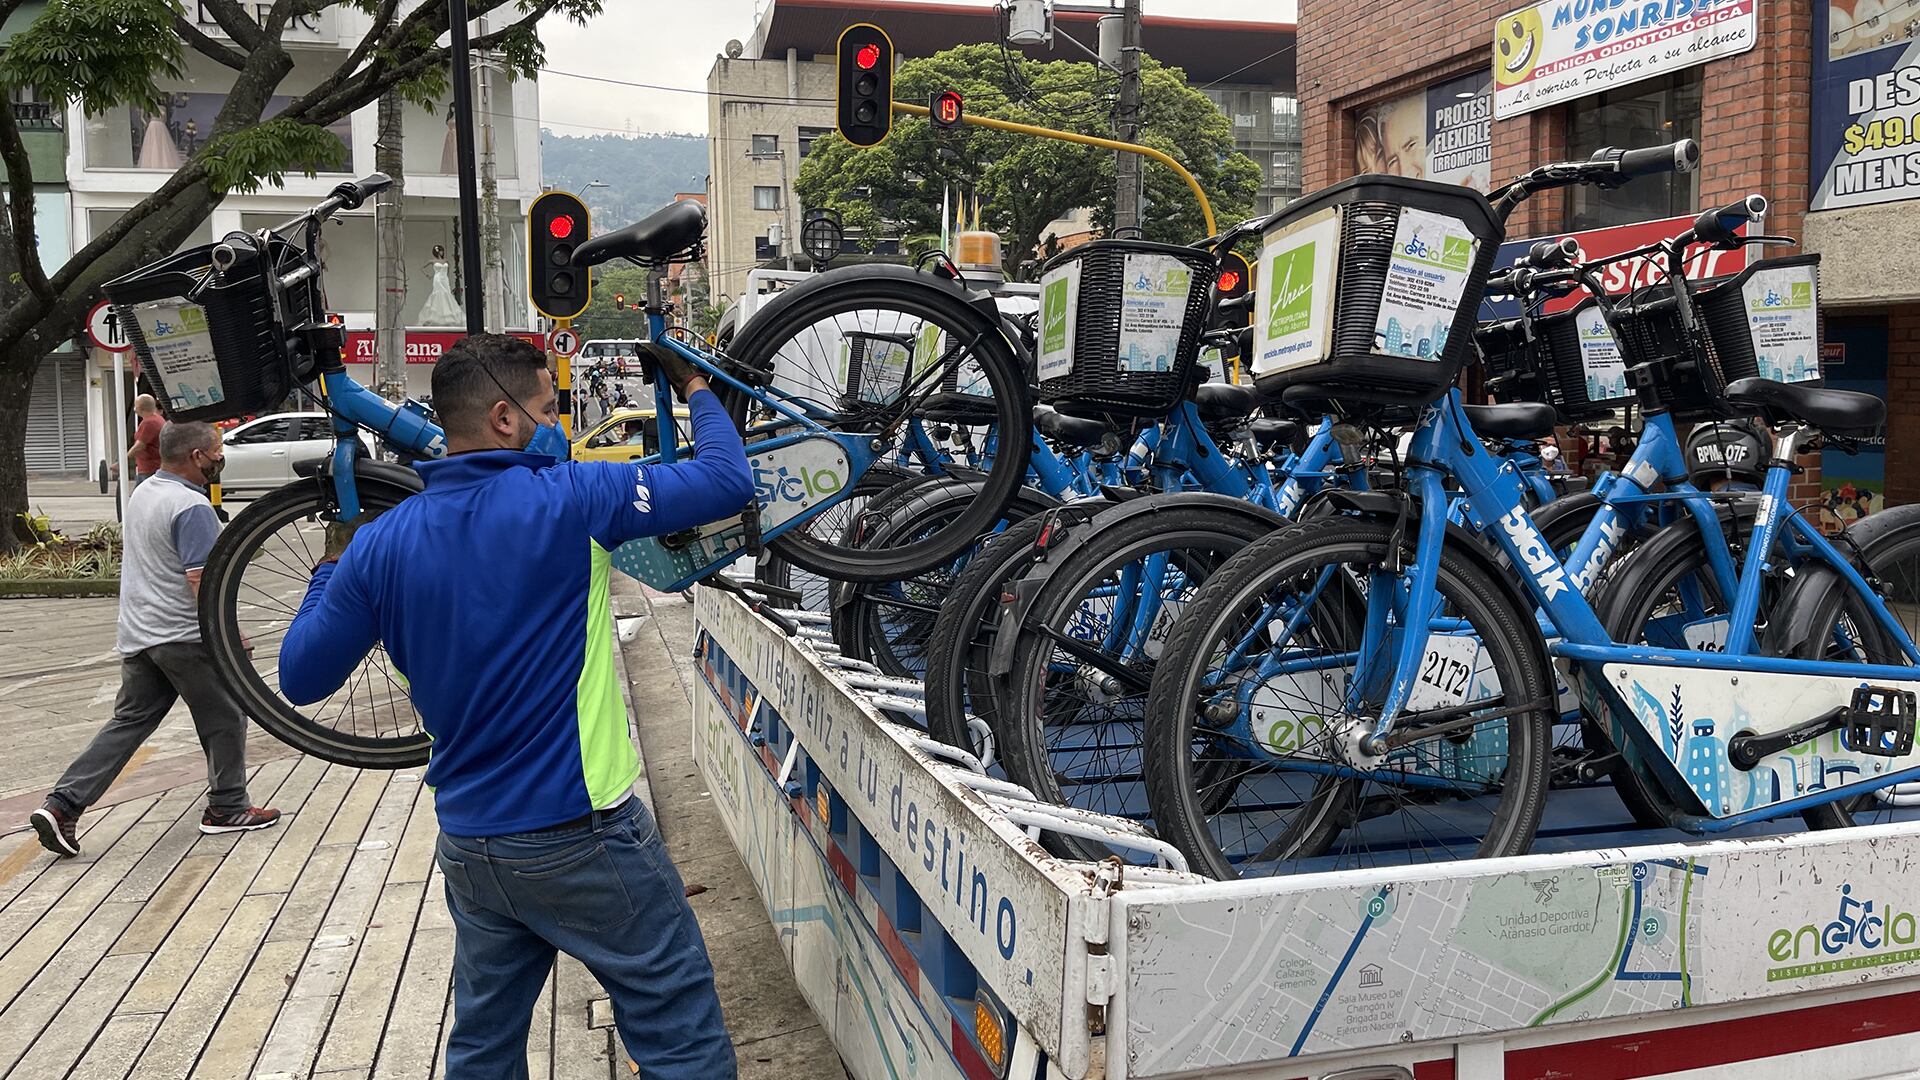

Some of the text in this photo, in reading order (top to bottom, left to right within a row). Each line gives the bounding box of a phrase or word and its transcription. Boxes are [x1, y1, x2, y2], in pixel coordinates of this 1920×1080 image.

[1534, 5, 1744, 80] CLÍNICA ODONTOLÓGICA
[1535, 78, 1580, 97] sonrisa
[1583, 57, 1644, 84] Perfecta
[1648, 54, 1659, 65] a
[1663, 46, 1682, 59] su
[1687, 27, 1747, 53] alcance
[942, 99, 956, 121] 19
[356, 339, 442, 356] Alana
[1421, 650, 1470, 697] 2172
[840, 730, 849, 773] a
[858, 742, 878, 808] tu
[1633, 866, 1646, 877] 24
[1371, 902, 1382, 914] 19
[1499, 909, 1590, 927] Unidad Deportiva
[1499, 921, 1592, 941] Atanasio Girardot
[1645, 922, 1658, 933] 23
[1358, 991, 1387, 1003] Museo
[1388, 988, 1404, 999] Del
[1346, 1011, 1395, 1026] Brigada Del
[1369, 1020, 1406, 1033] Nacional
